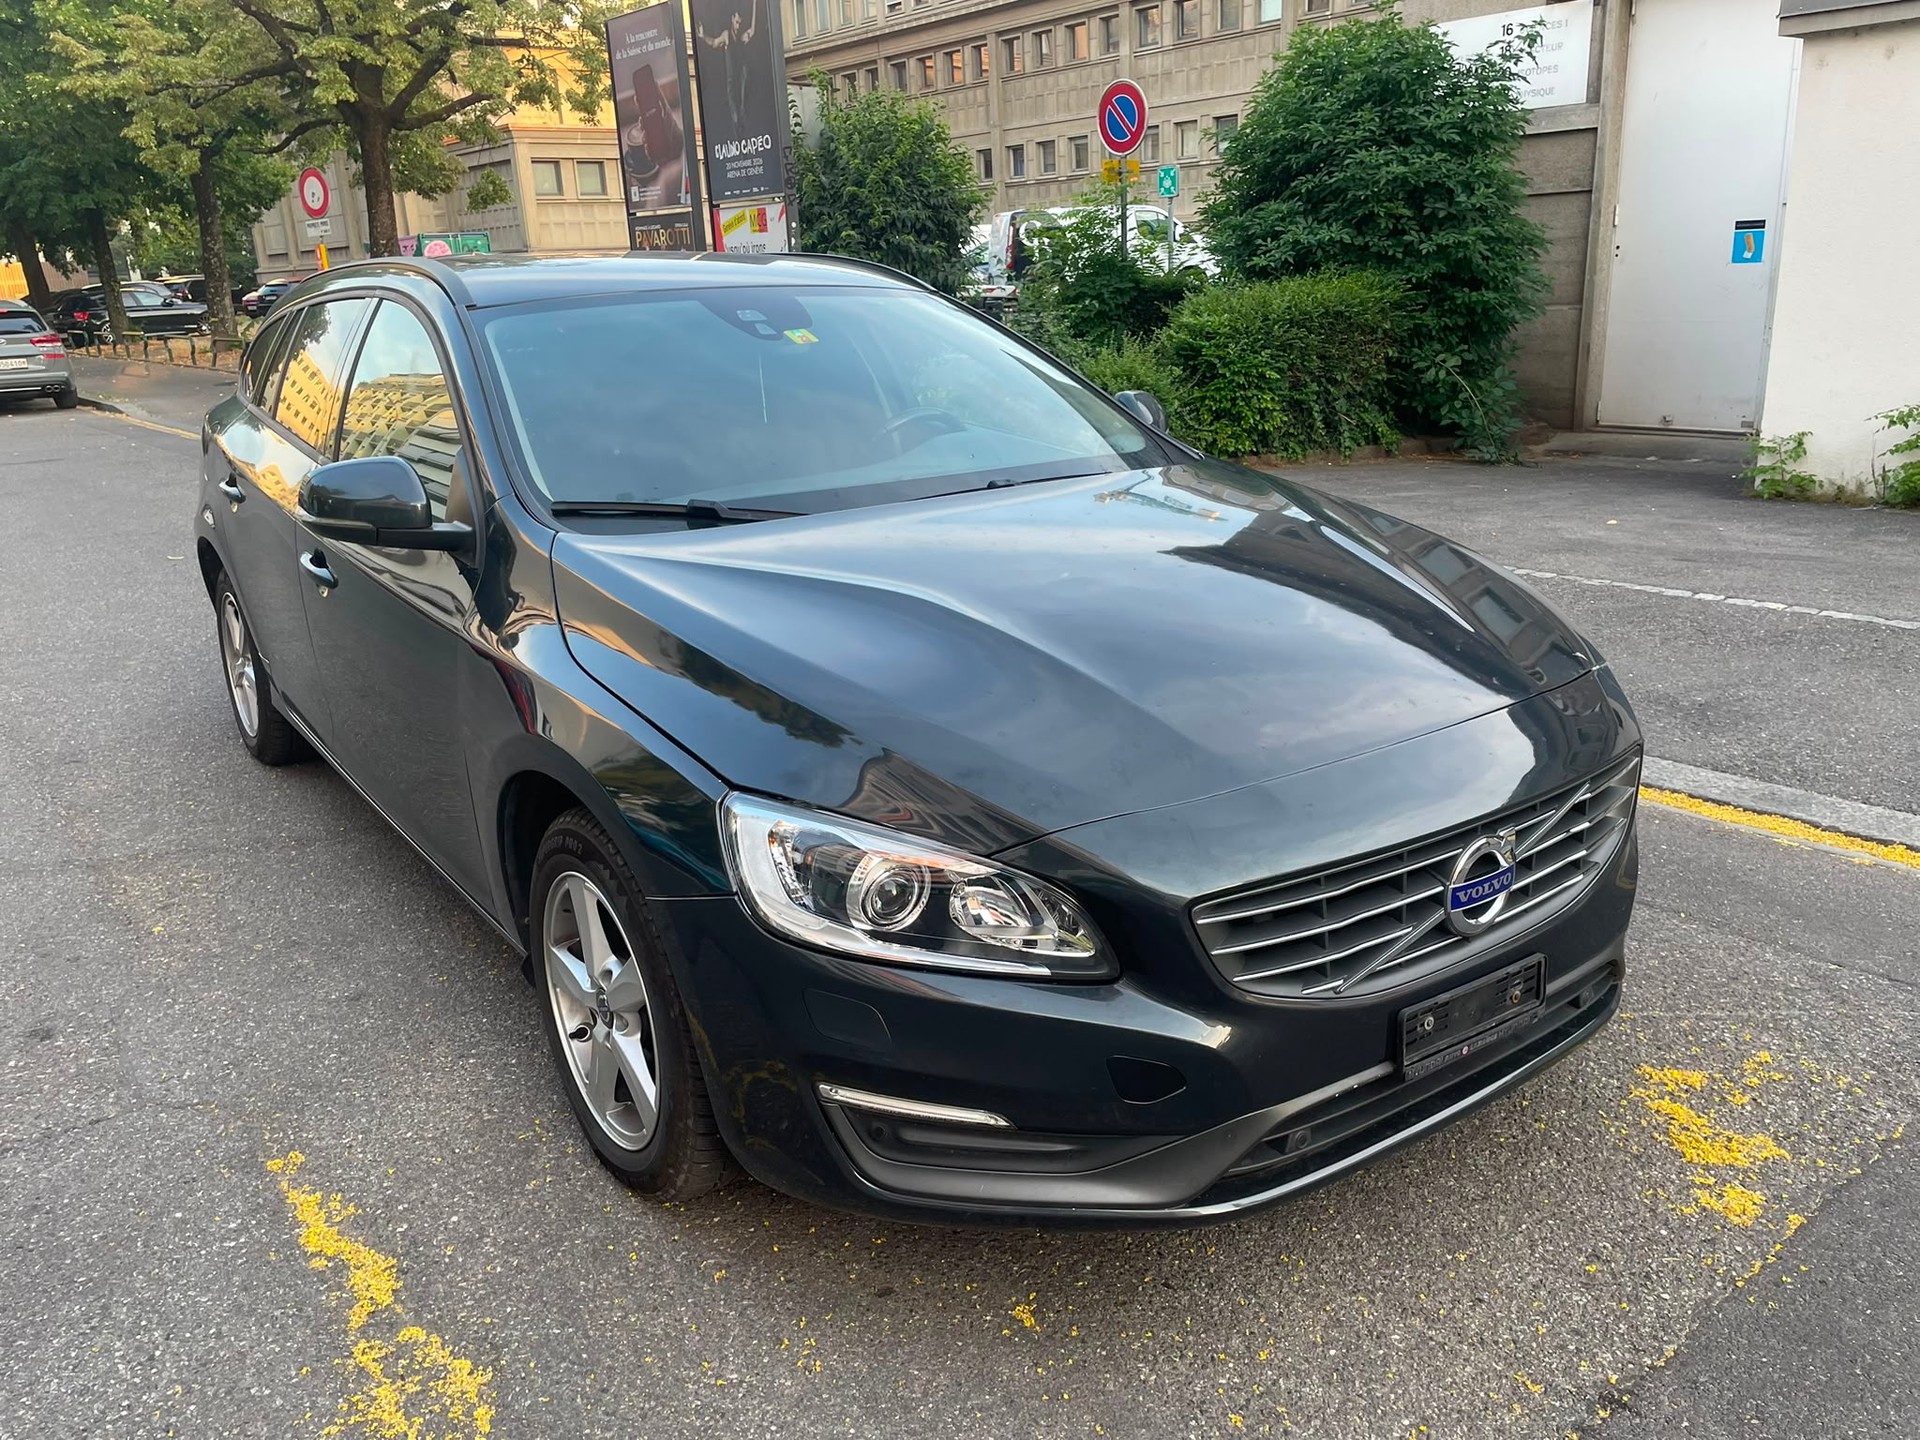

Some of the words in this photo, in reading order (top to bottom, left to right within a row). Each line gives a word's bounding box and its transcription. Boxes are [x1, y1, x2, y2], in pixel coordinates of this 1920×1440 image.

[1501, 22, 1514, 37] 16
[749, 212, 768, 227] MCG
[635, 227, 690, 248] PAVAROTTI
[1456, 872, 1512, 903] VOLVO
